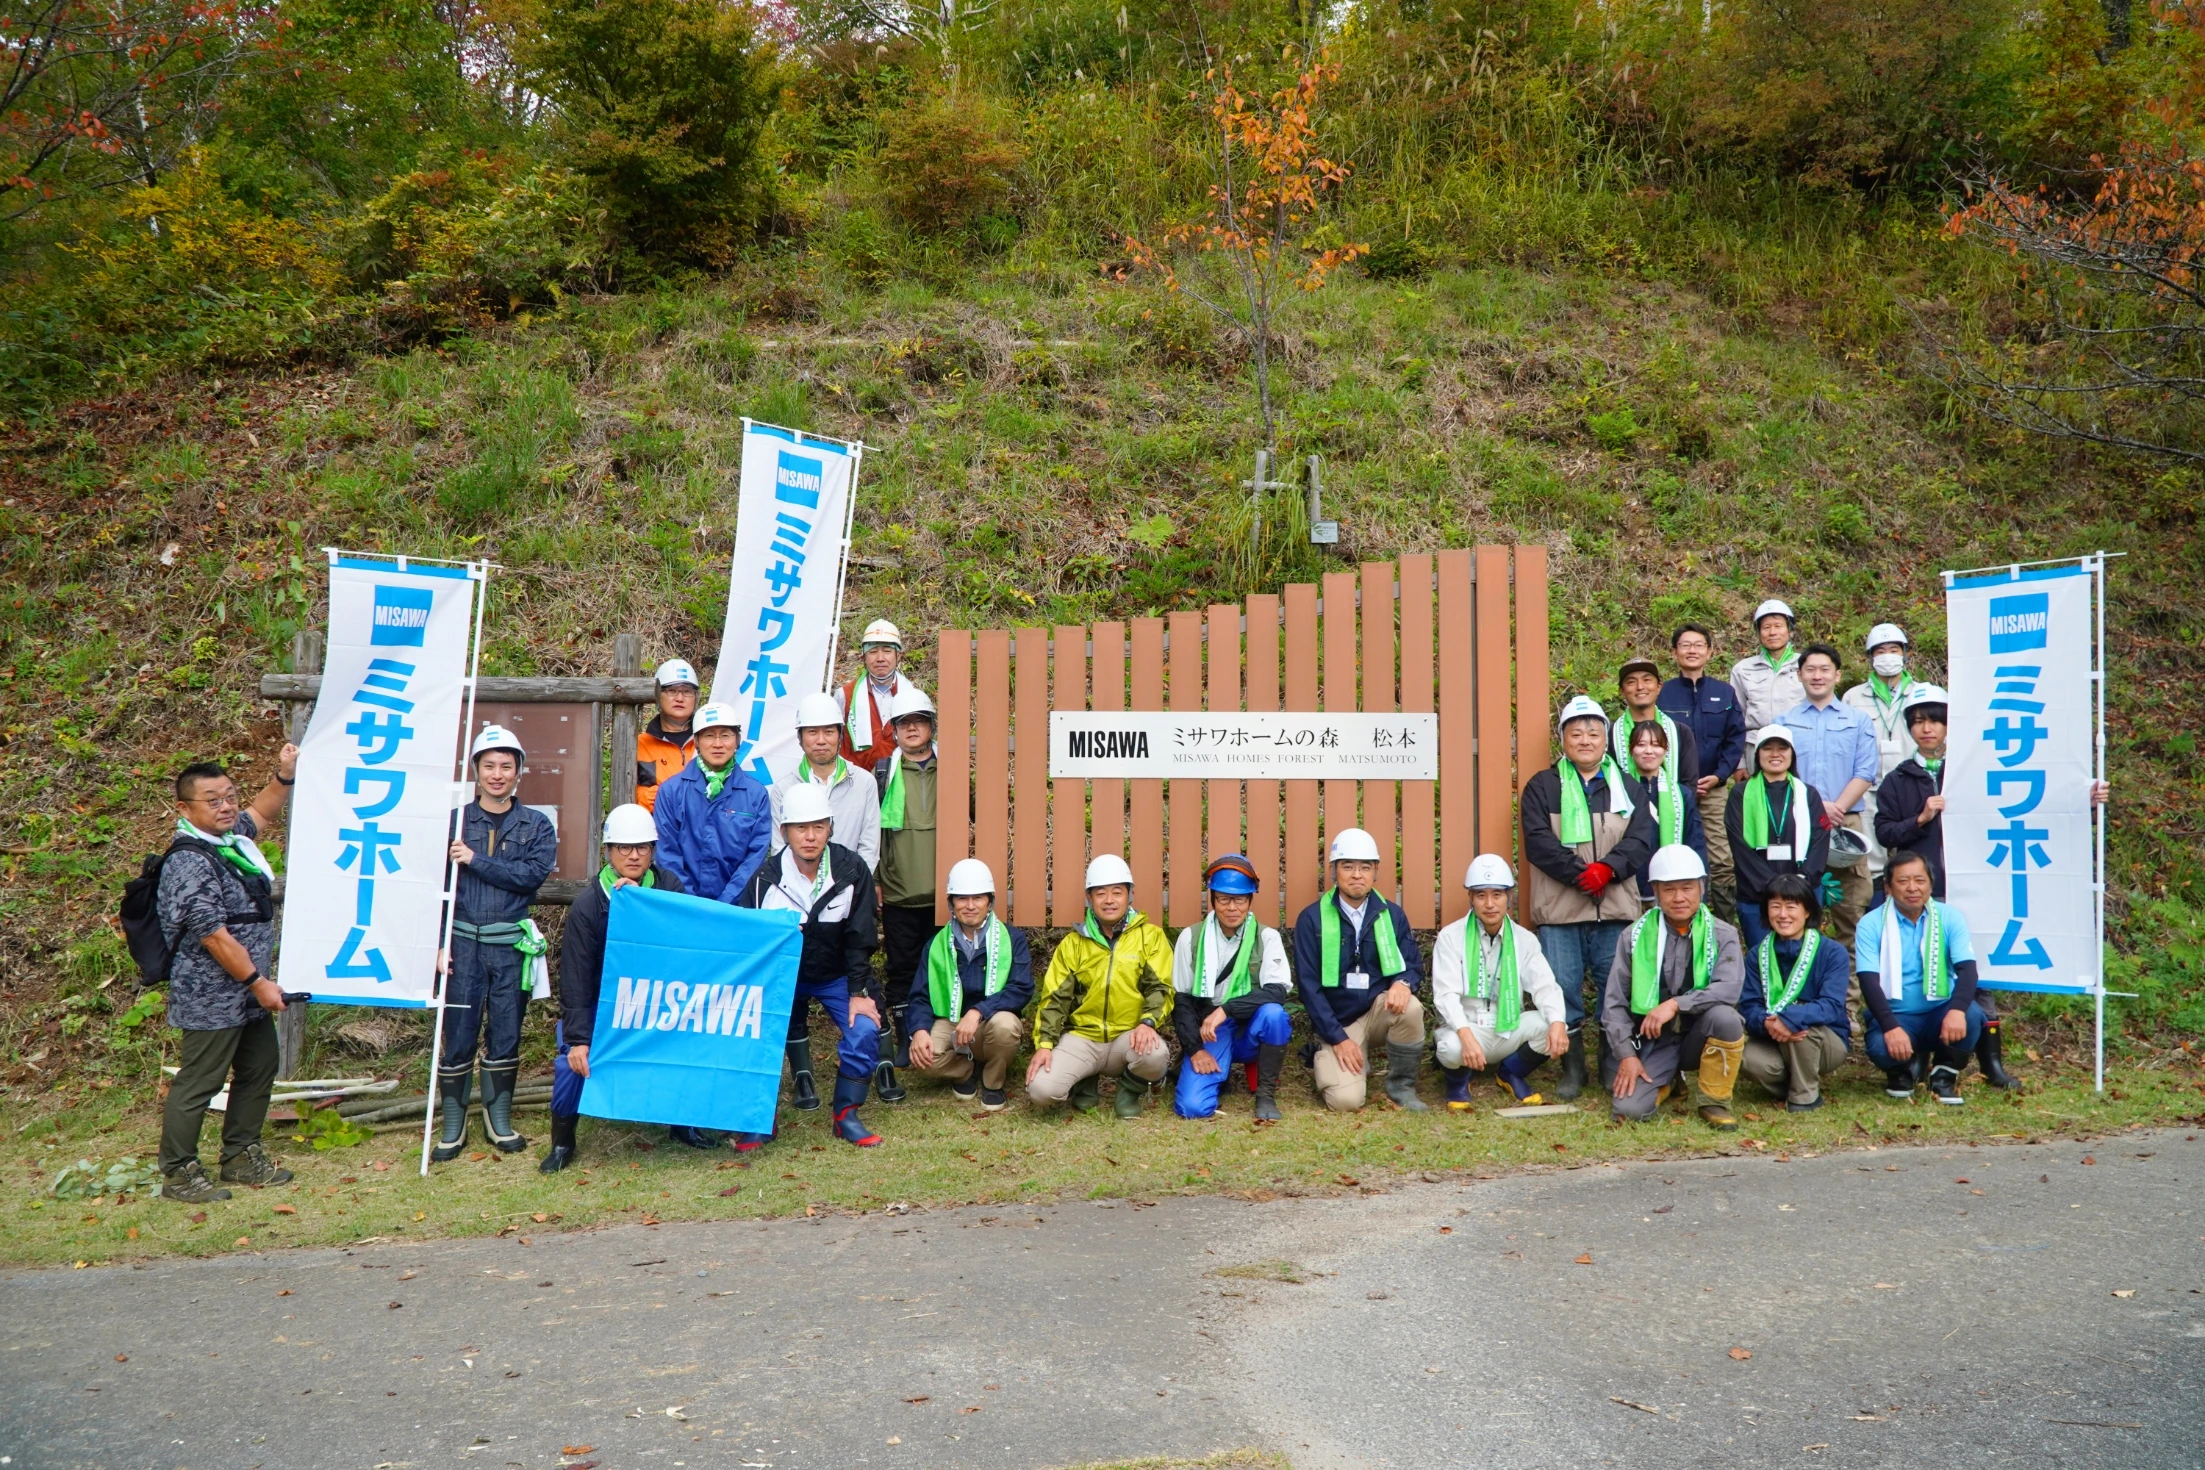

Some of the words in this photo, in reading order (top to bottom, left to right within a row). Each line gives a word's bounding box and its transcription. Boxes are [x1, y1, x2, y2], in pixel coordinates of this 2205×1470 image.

[777, 467, 820, 492] MISAWA
[375, 604, 428, 629] MISAWA
[1991, 612, 2046, 635] MISAWA
[735, 512, 811, 786] ミサワホーム
[1069, 731, 1149, 758] MISAWA
[1173, 727, 1339, 749] ミサワホームの森
[1372, 727, 1416, 749] 松本
[1173, 753, 1219, 763] MISAWA
[1227, 754, 1270, 763] HOMES
[1278, 754, 1324, 763] FOREST
[1338, 754, 1417, 764] MATSUMOTO
[326, 658, 415, 983] ミサワホーム
[1982, 666, 2053, 970] ミサワホーム
[612, 977, 763, 1039] MISAWA
